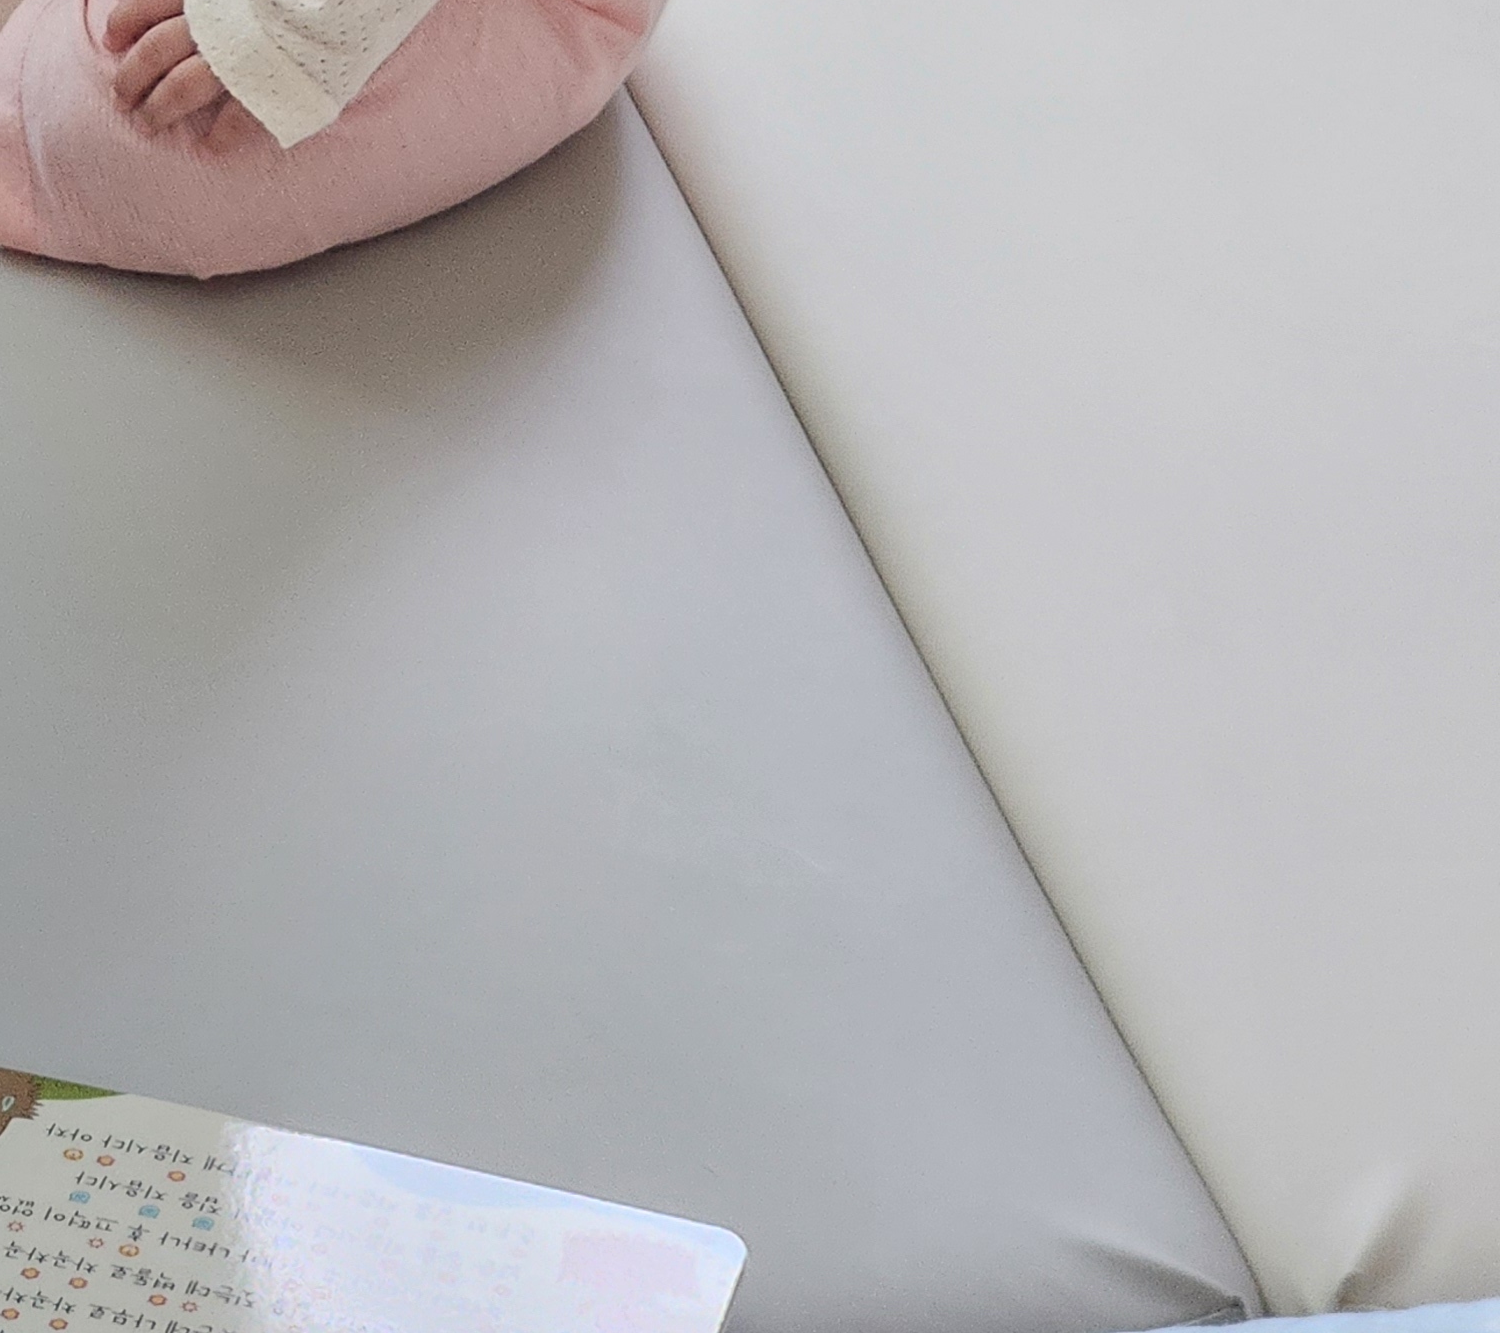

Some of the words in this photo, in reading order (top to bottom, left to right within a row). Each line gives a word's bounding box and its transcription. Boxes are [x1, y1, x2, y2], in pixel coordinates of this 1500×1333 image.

[45, 1122, 93, 1143] 아자
[100, 1133, 195, 1166] 지읍시다
[74, 1170, 168, 1202] 지읍시다
[178, 1191, 223, 1216] 집을
[2, 1239, 99, 1275] 차곡차곡
[157, 1230, 235, 1260] 나타나
[184, 1279, 256, 1309] 짓는데
[87, 1302, 158, 1331] 나무로
